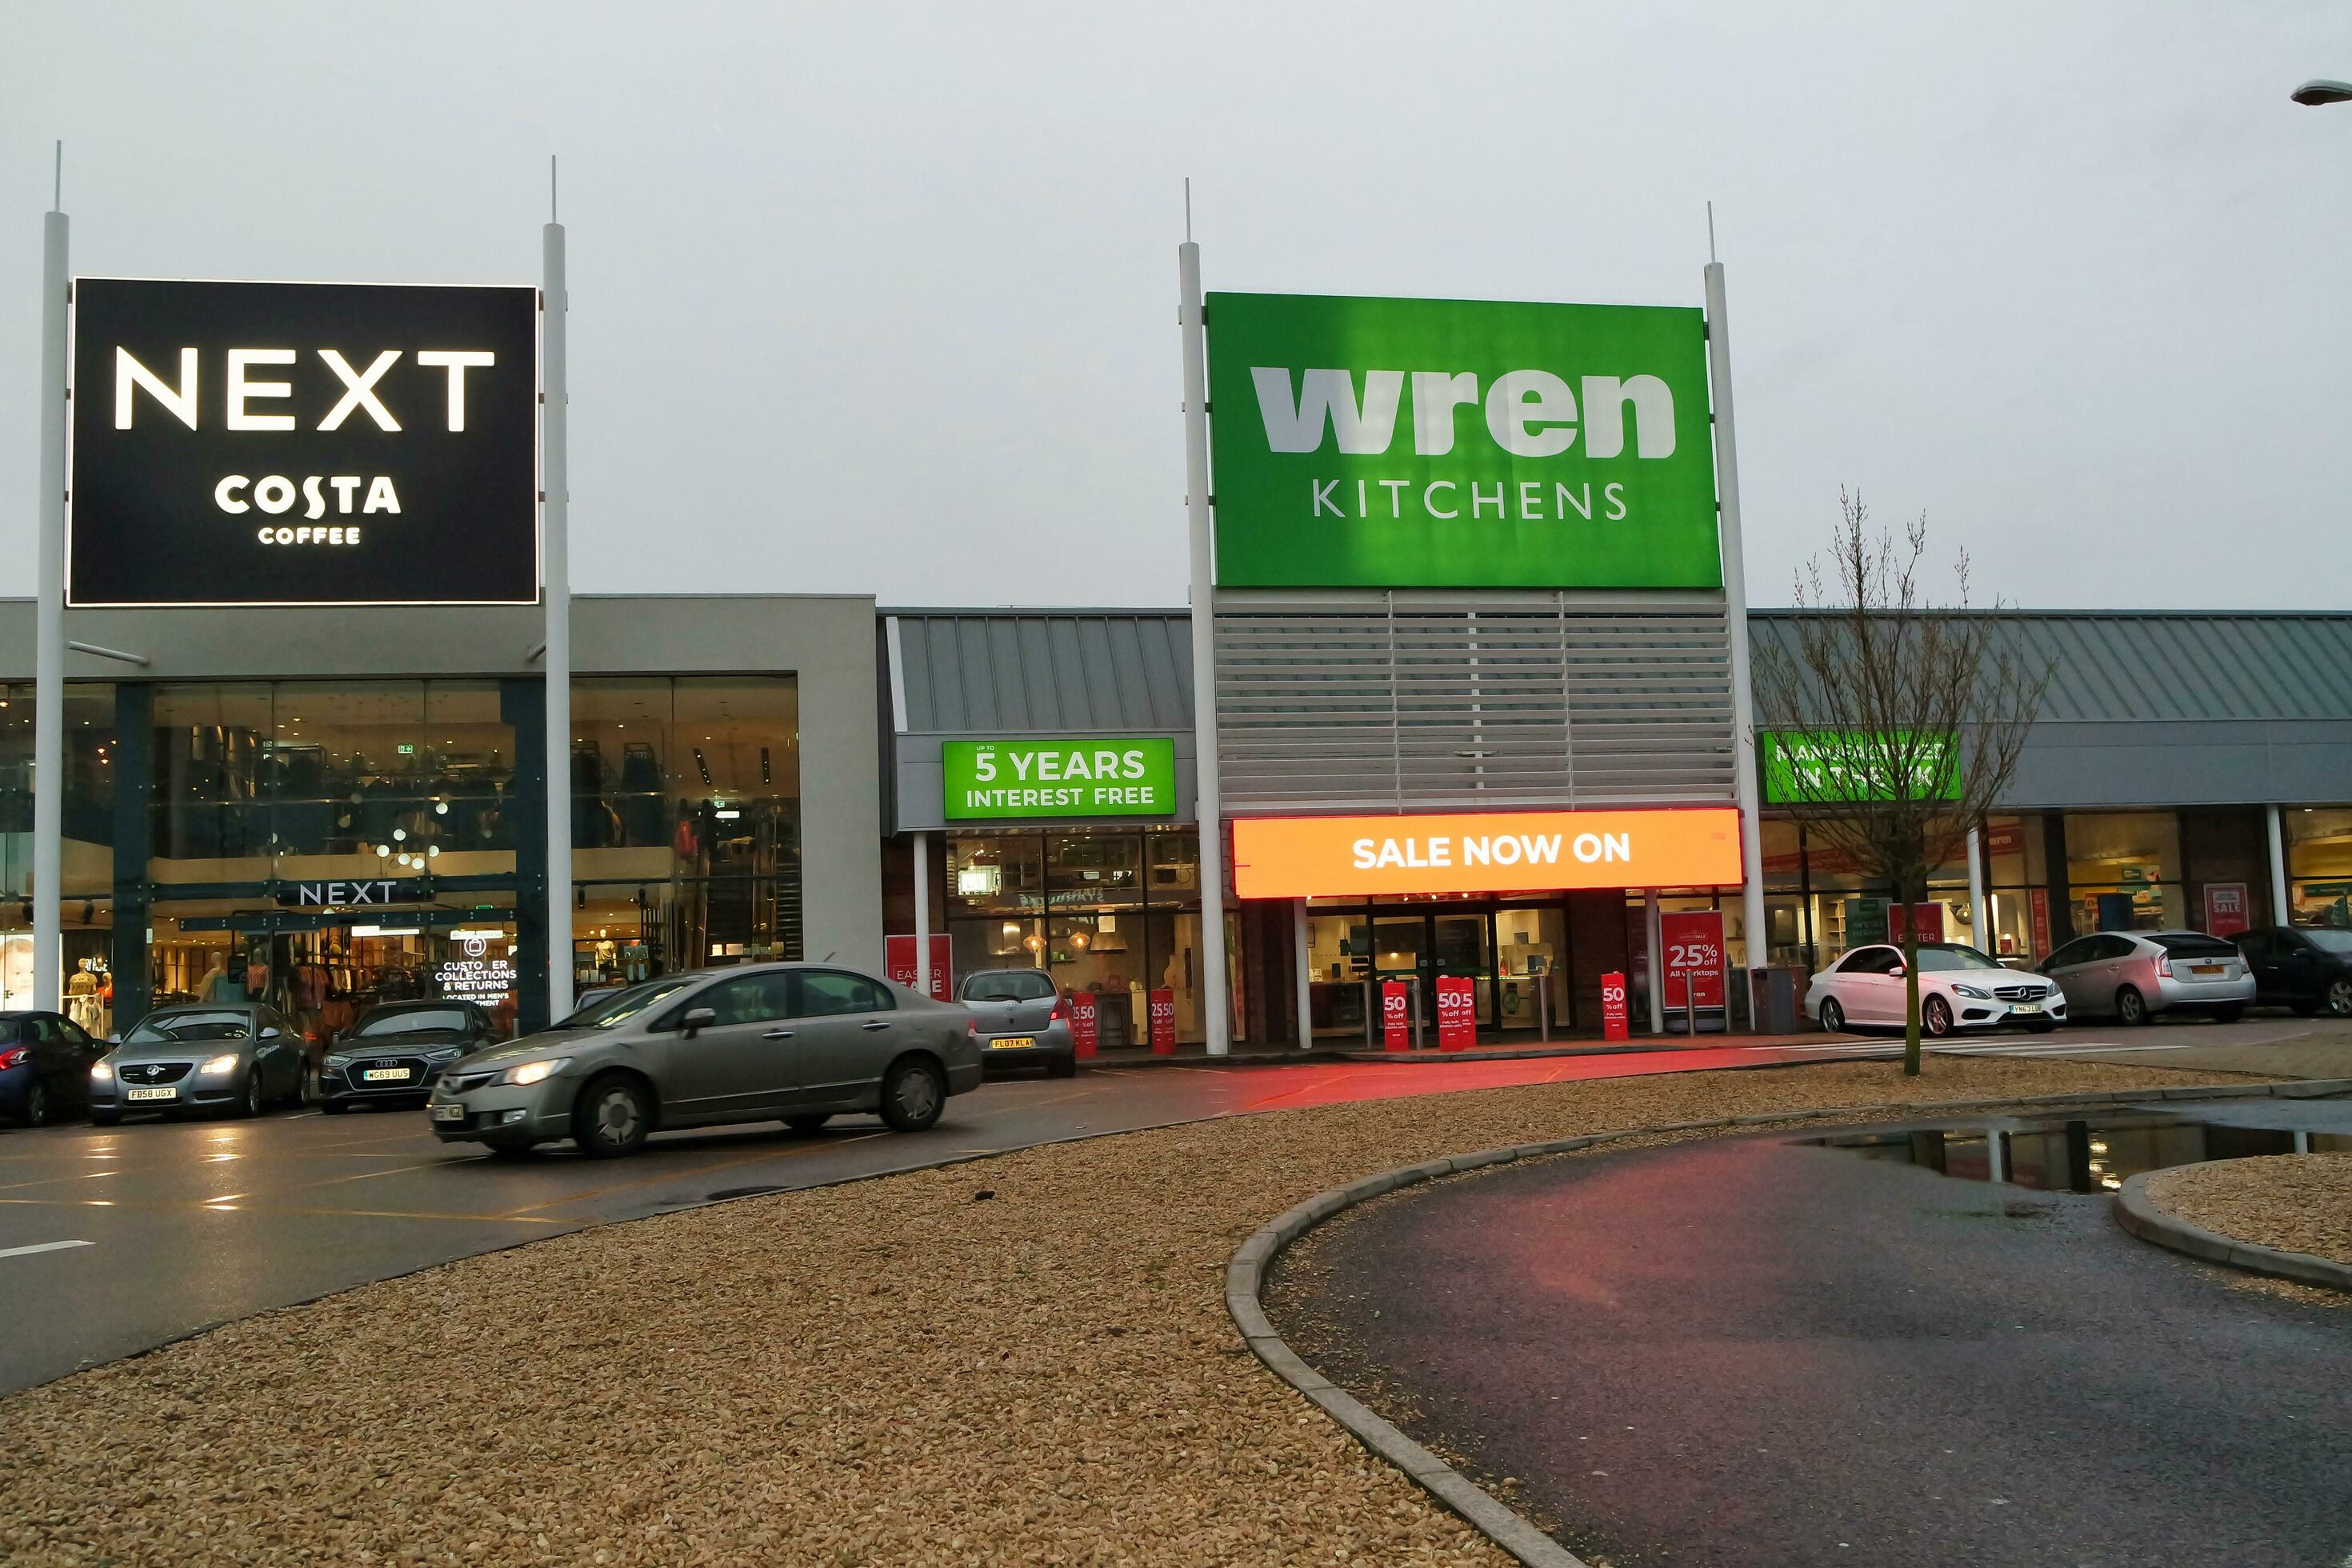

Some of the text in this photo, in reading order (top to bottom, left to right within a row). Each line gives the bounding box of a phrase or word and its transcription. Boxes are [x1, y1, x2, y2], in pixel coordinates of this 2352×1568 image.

[114, 345, 495, 433] NEXT
[1250, 366, 1677, 459] wren
[214, 474, 402, 520] COSTA
[1312, 478, 1627, 521] KITCHENS
[258, 526, 361, 546] COFFEE
[974, 750, 1145, 782] 5 YEARS
[966, 786, 1155, 808] INTEREST FREE
[1352, 832, 1630, 870] SALE NOW ON
[299, 881, 397, 906] NEXT
[2213, 902, 2241, 913] SALE
[1898, 933, 1935, 943] ETER
[1669, 944, 1718, 967] 25%
[1704, 958, 1718, 966] off
[443, 960, 508, 971] CUSTOER
[434, 970, 517, 982] COLLECTIONS
[897, 968, 942, 980] EASER
[1682, 969, 1719, 978] wrktops
[443, 980, 509, 991] & RETURNS
[442, 993, 477, 1001] LOCATED
[486, 992, 510, 1000] MEN'S
[1438, 992, 1461, 1008] 50
[1602, 987, 1625, 1002] 50
[1152, 1003, 1163, 1017] 25
[1163, 1002, 1174, 1017] 50
[1384, 996, 1406, 1011] 50
[1080, 1006, 1095, 1020] 50
[1015, 1039, 1030, 1047] KLA
[392, 1070, 409, 1078] UUS
[155, 1089, 172, 1098] UGX
